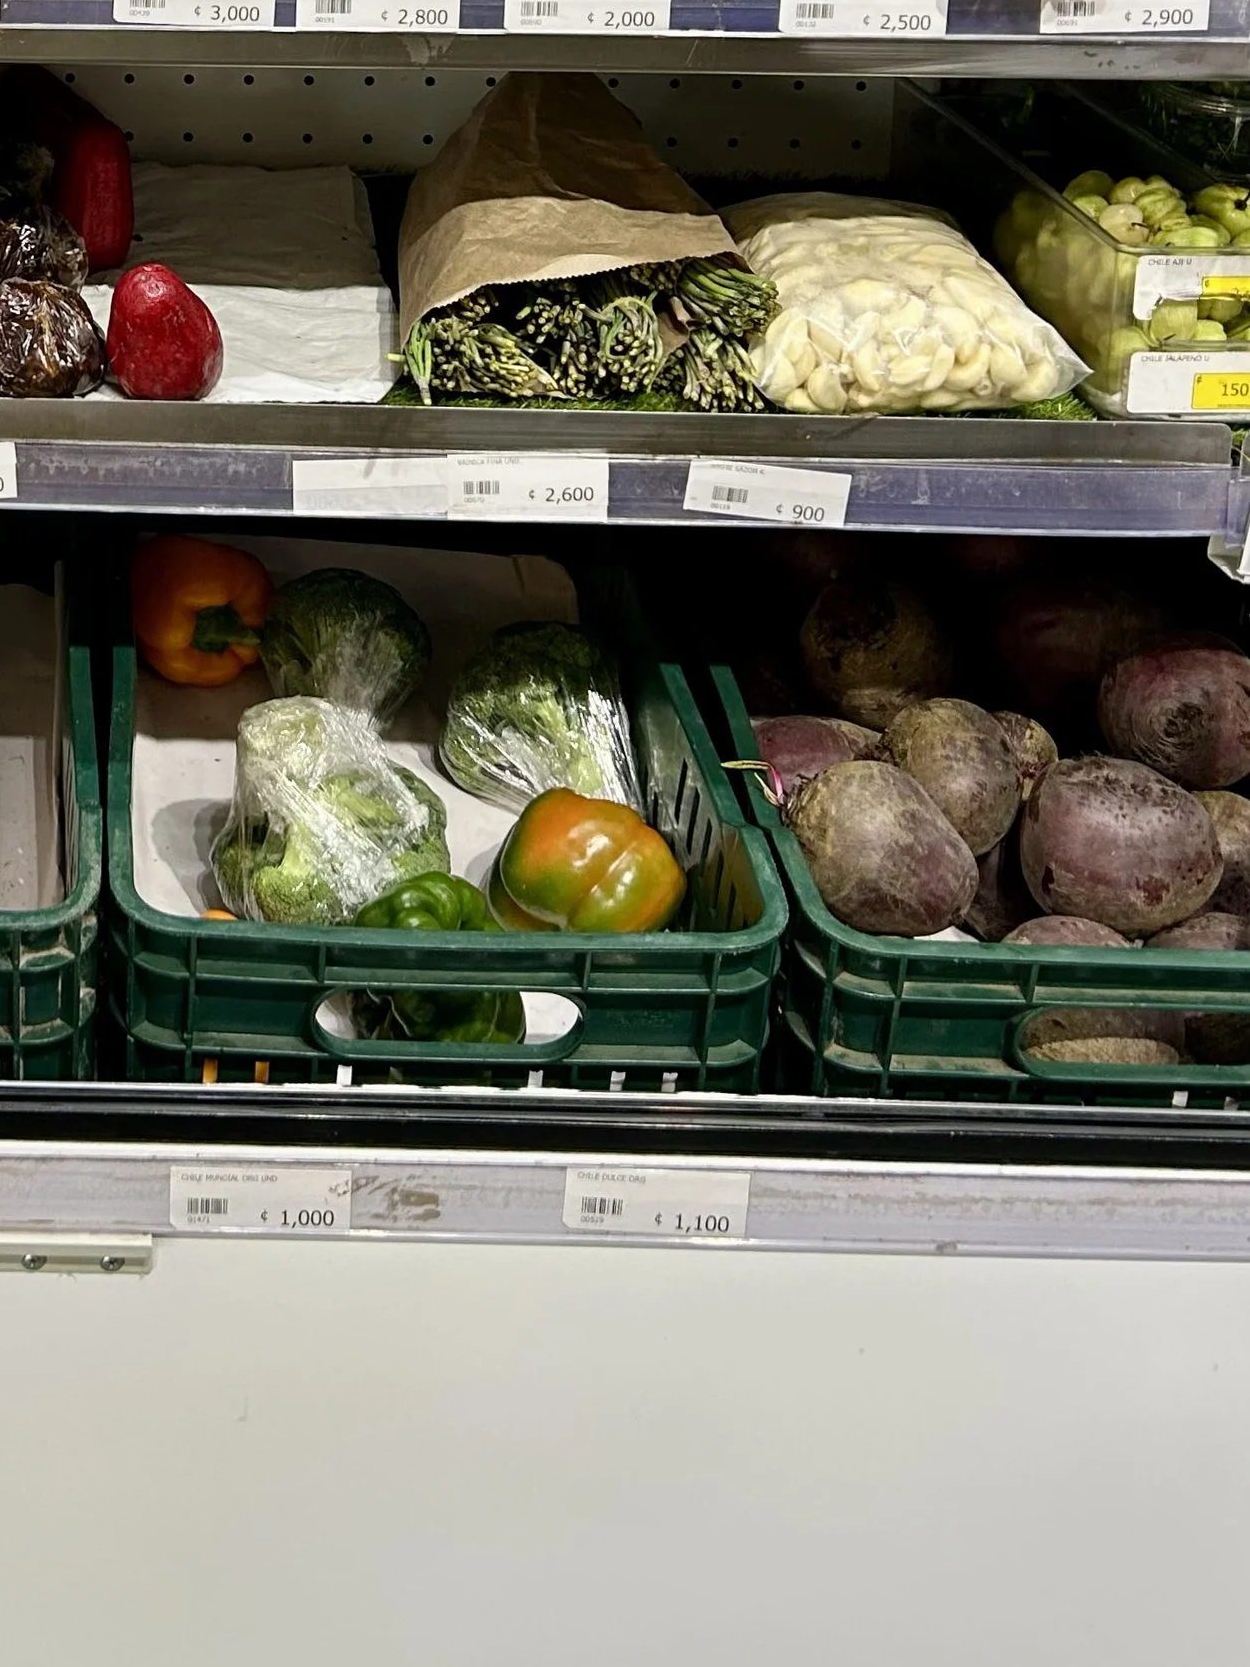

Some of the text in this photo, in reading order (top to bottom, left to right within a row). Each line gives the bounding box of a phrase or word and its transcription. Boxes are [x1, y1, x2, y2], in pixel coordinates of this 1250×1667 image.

[211, 5, 259, 23] 3,000
[398, 9, 447, 27] 2,800
[605, 12, 654, 29] 2,000
[880, 14, 931, 32] 2,500
[1142, 9, 1193, 27] 2,900
[1222, 383, 1249, 396] 150
[546, 487, 593, 504] 2,600
[791, 505, 824, 523] 900
[282, 1210, 334, 1228] 1,000
[676, 1214, 729, 1233] 1,100
